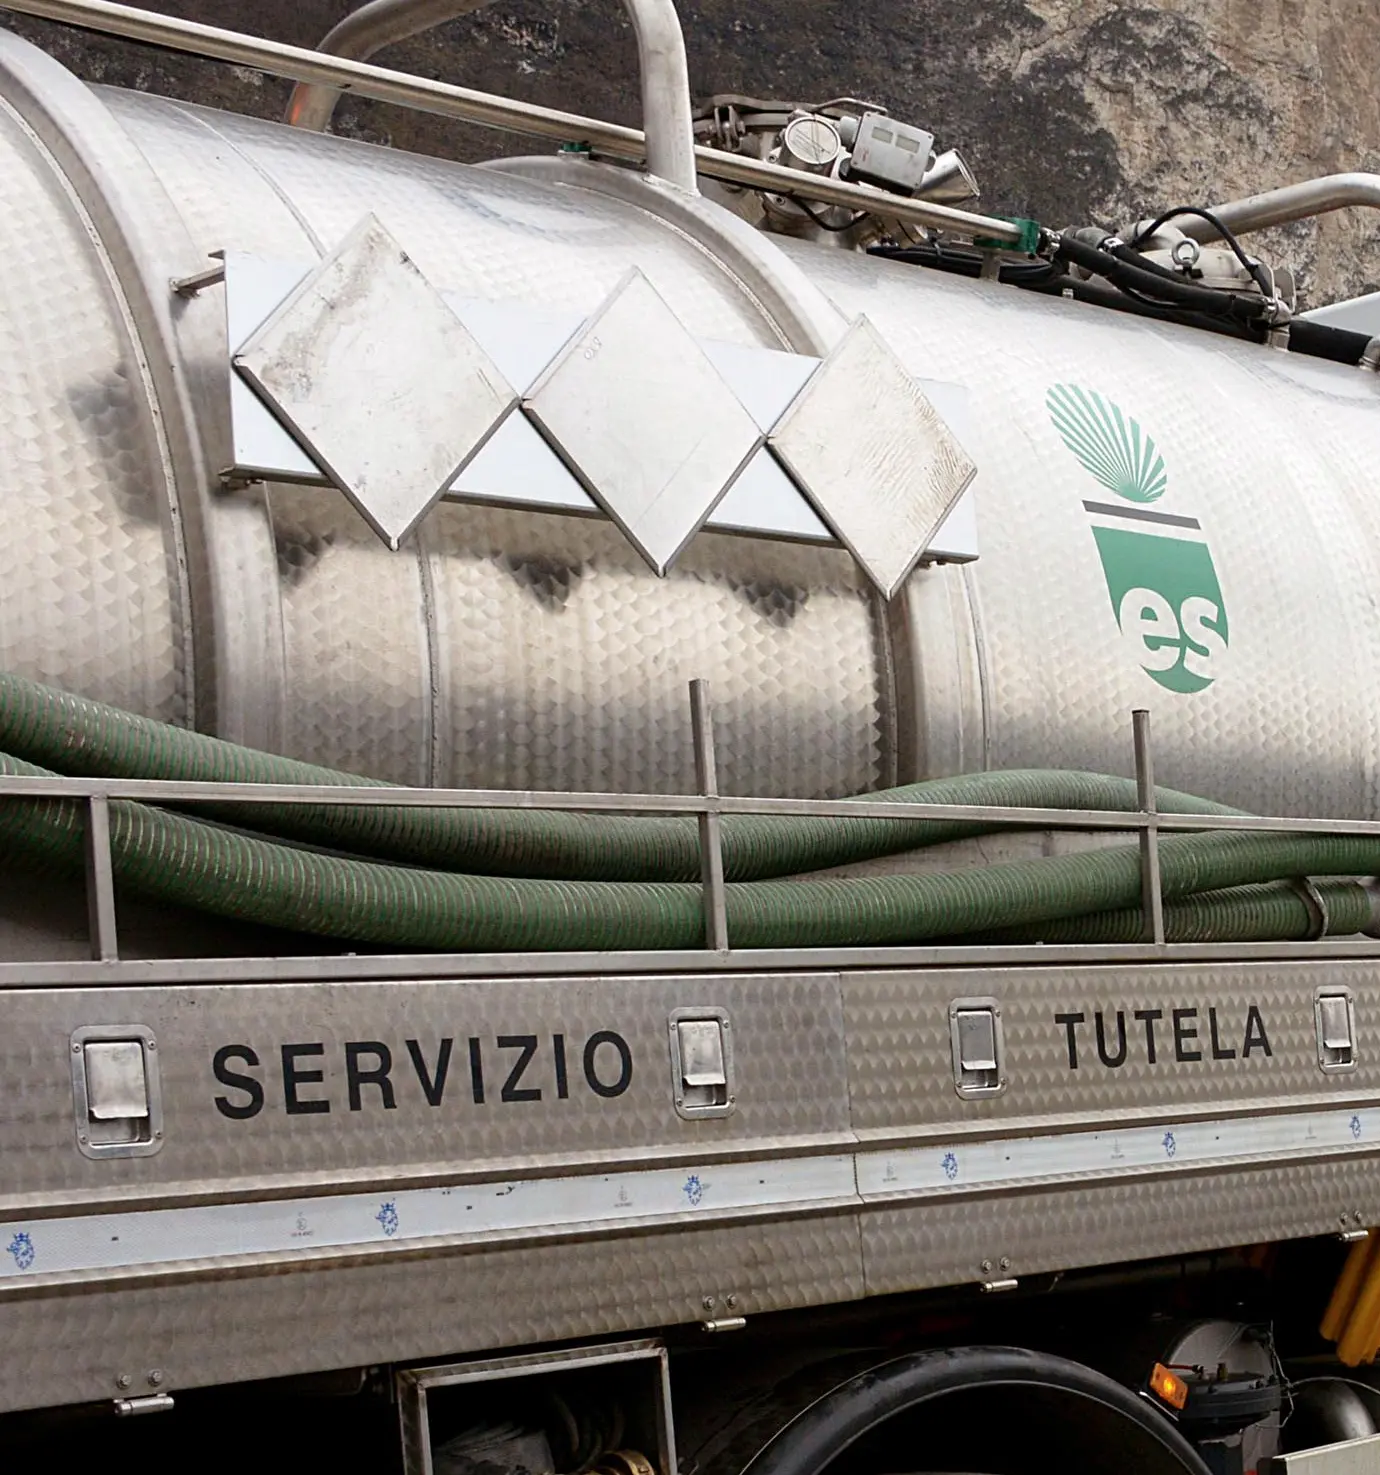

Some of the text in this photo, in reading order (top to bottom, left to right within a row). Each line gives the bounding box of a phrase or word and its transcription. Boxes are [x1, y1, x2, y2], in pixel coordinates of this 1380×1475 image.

[1119, 587, 1229, 681] es
[212, 1030, 633, 1120] SERVIZIO
[1054, 1005, 1273, 1070] TUTELA
